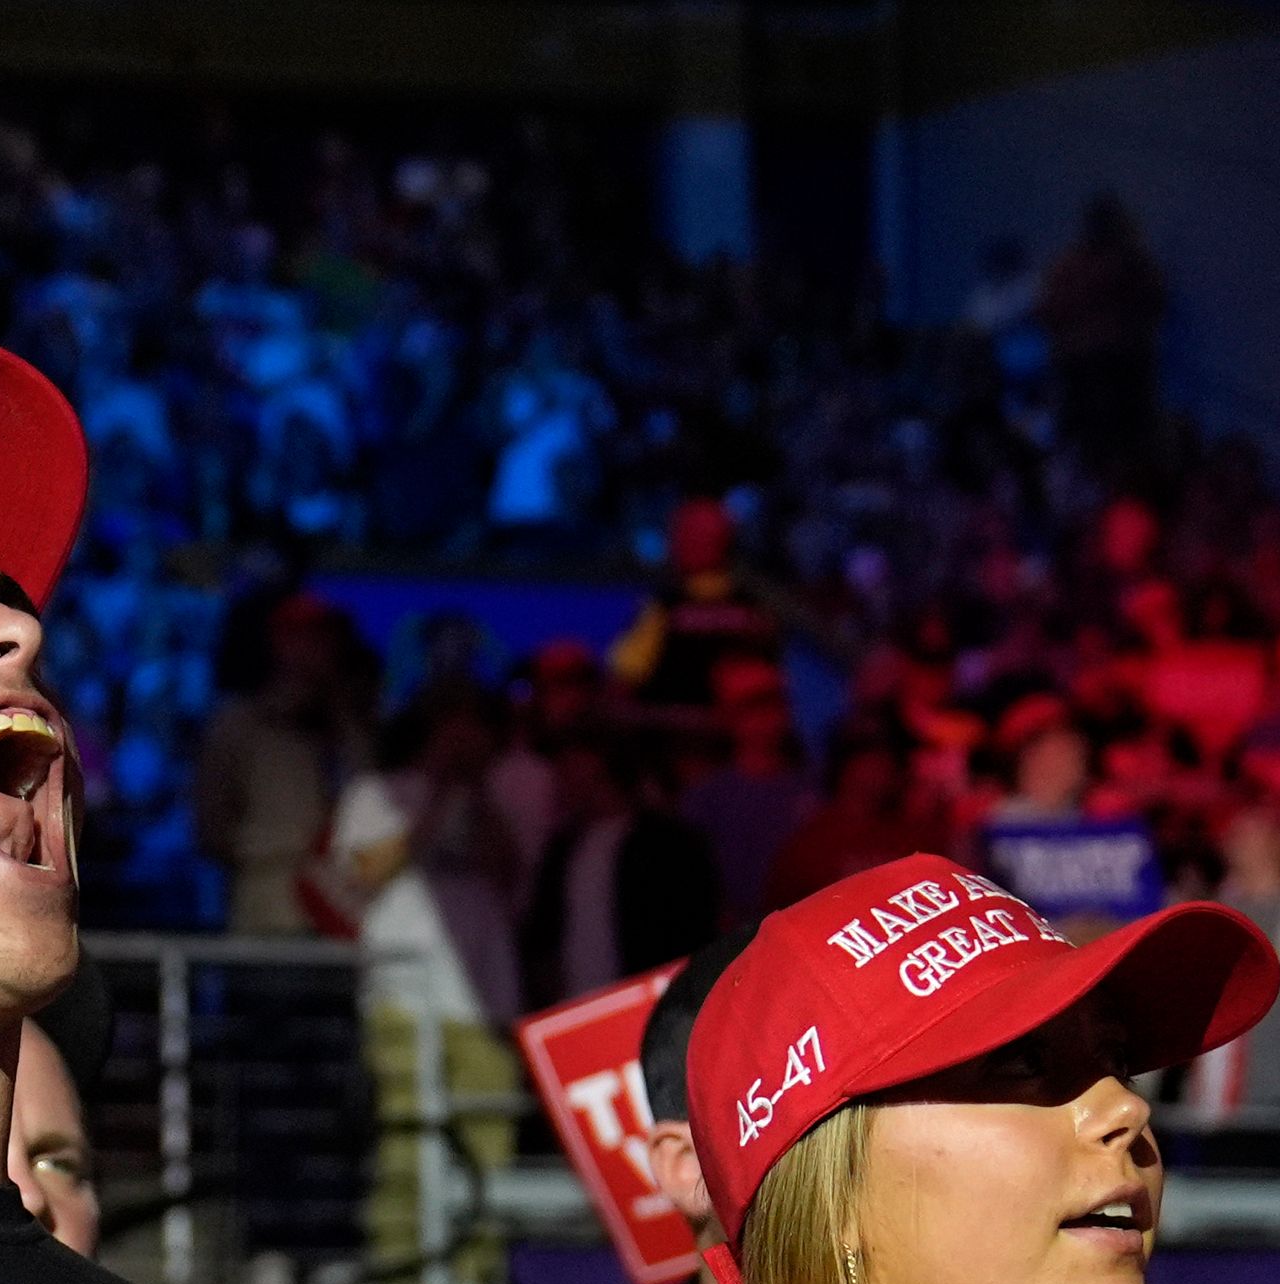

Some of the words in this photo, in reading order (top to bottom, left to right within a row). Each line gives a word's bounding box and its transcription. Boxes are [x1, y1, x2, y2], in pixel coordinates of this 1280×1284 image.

[827, 879, 960, 969] MAKE
[898, 908, 1030, 998] GREAT
[736, 1025, 827, 1148] 45-47
